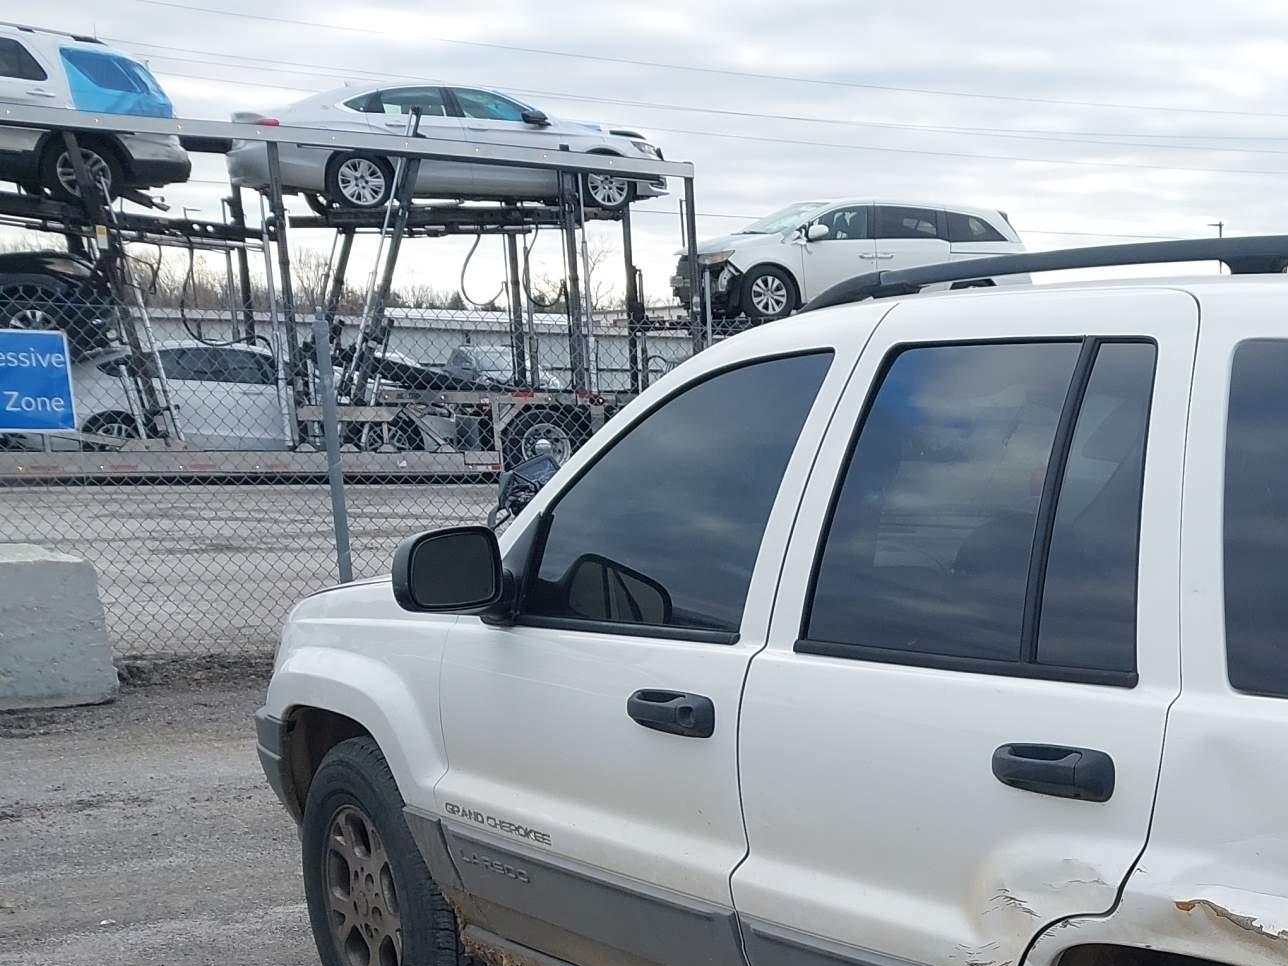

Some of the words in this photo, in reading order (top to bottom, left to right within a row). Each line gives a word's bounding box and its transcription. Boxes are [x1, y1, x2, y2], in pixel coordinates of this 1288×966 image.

[3, 391, 65, 412] Zone
[445, 802, 485, 824] GRAND
[487, 815, 552, 846] CHEROKEE
